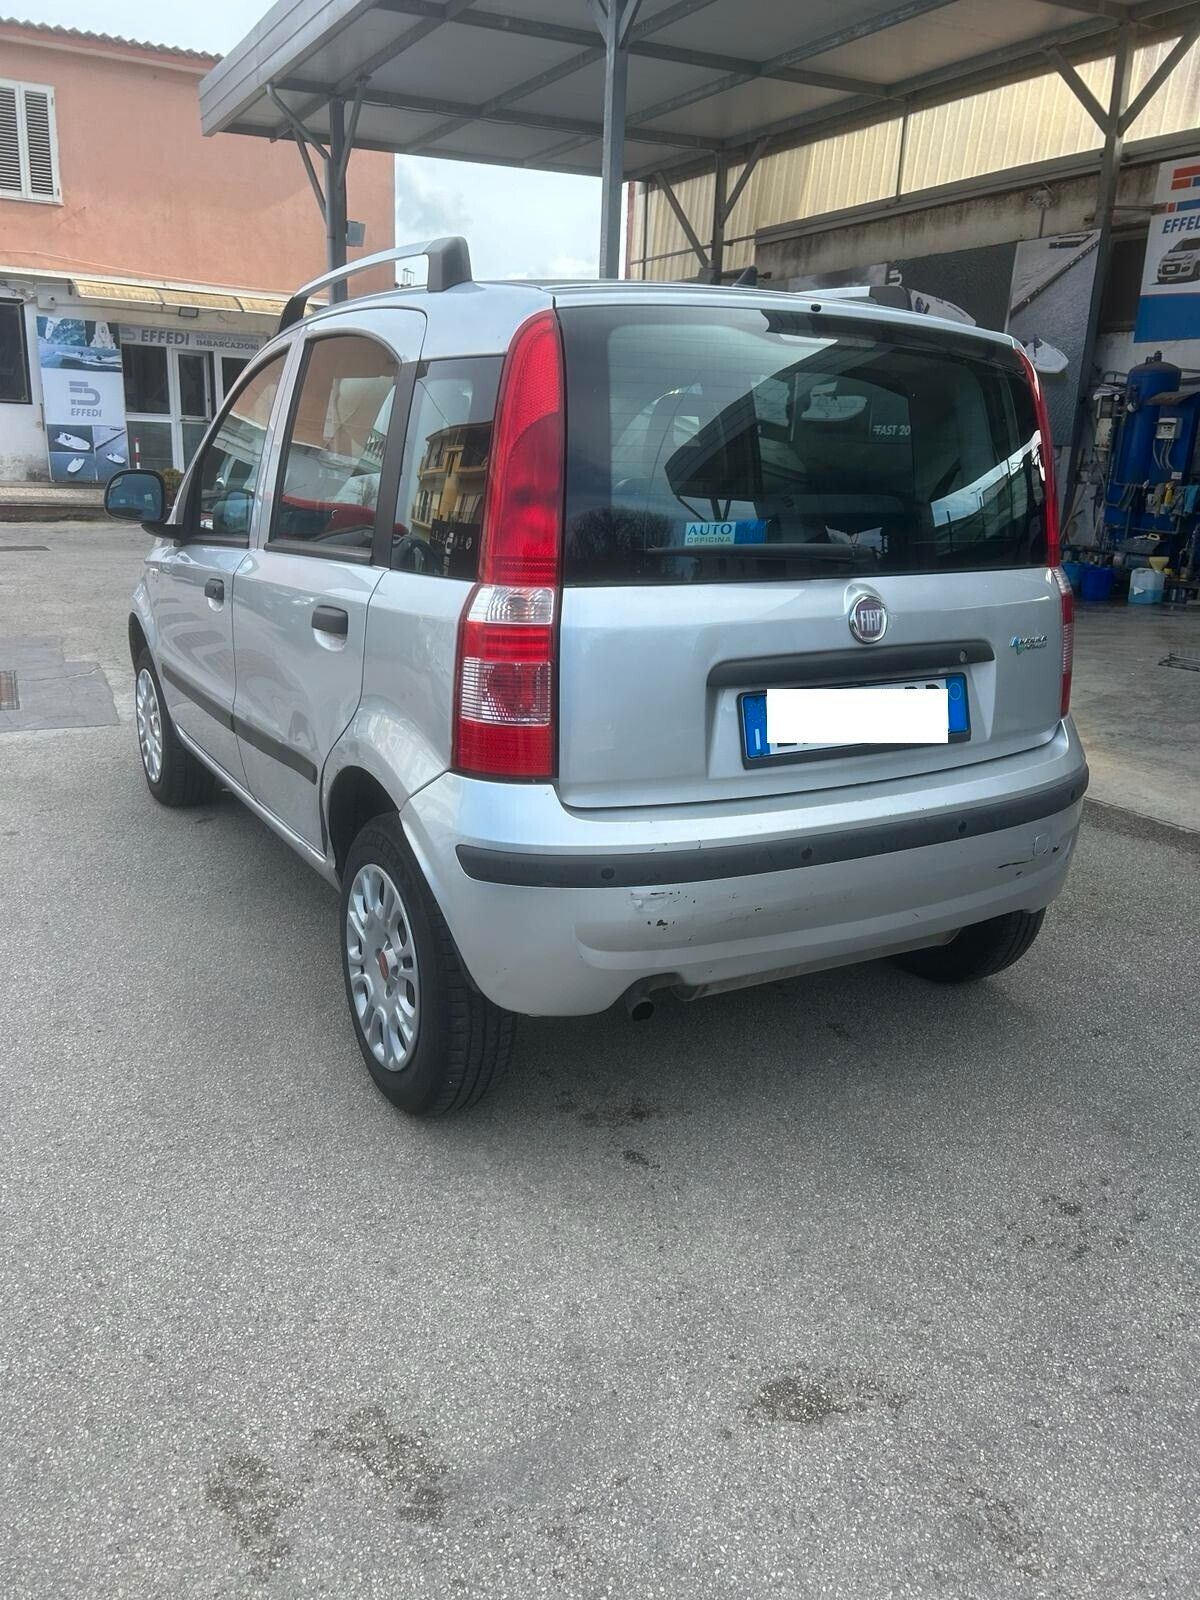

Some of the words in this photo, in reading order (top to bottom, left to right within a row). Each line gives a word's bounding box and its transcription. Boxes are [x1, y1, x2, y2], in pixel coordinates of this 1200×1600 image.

[141, 329, 190, 346] EFFEDI
[196, 340, 259, 350] IMBARCAZIONI
[71, 408, 102, 417] EFFEDI
[688, 523, 733, 536] AUTO
[687, 536, 732, 544] OFFICINA
[860, 609, 881, 631] FIAT
